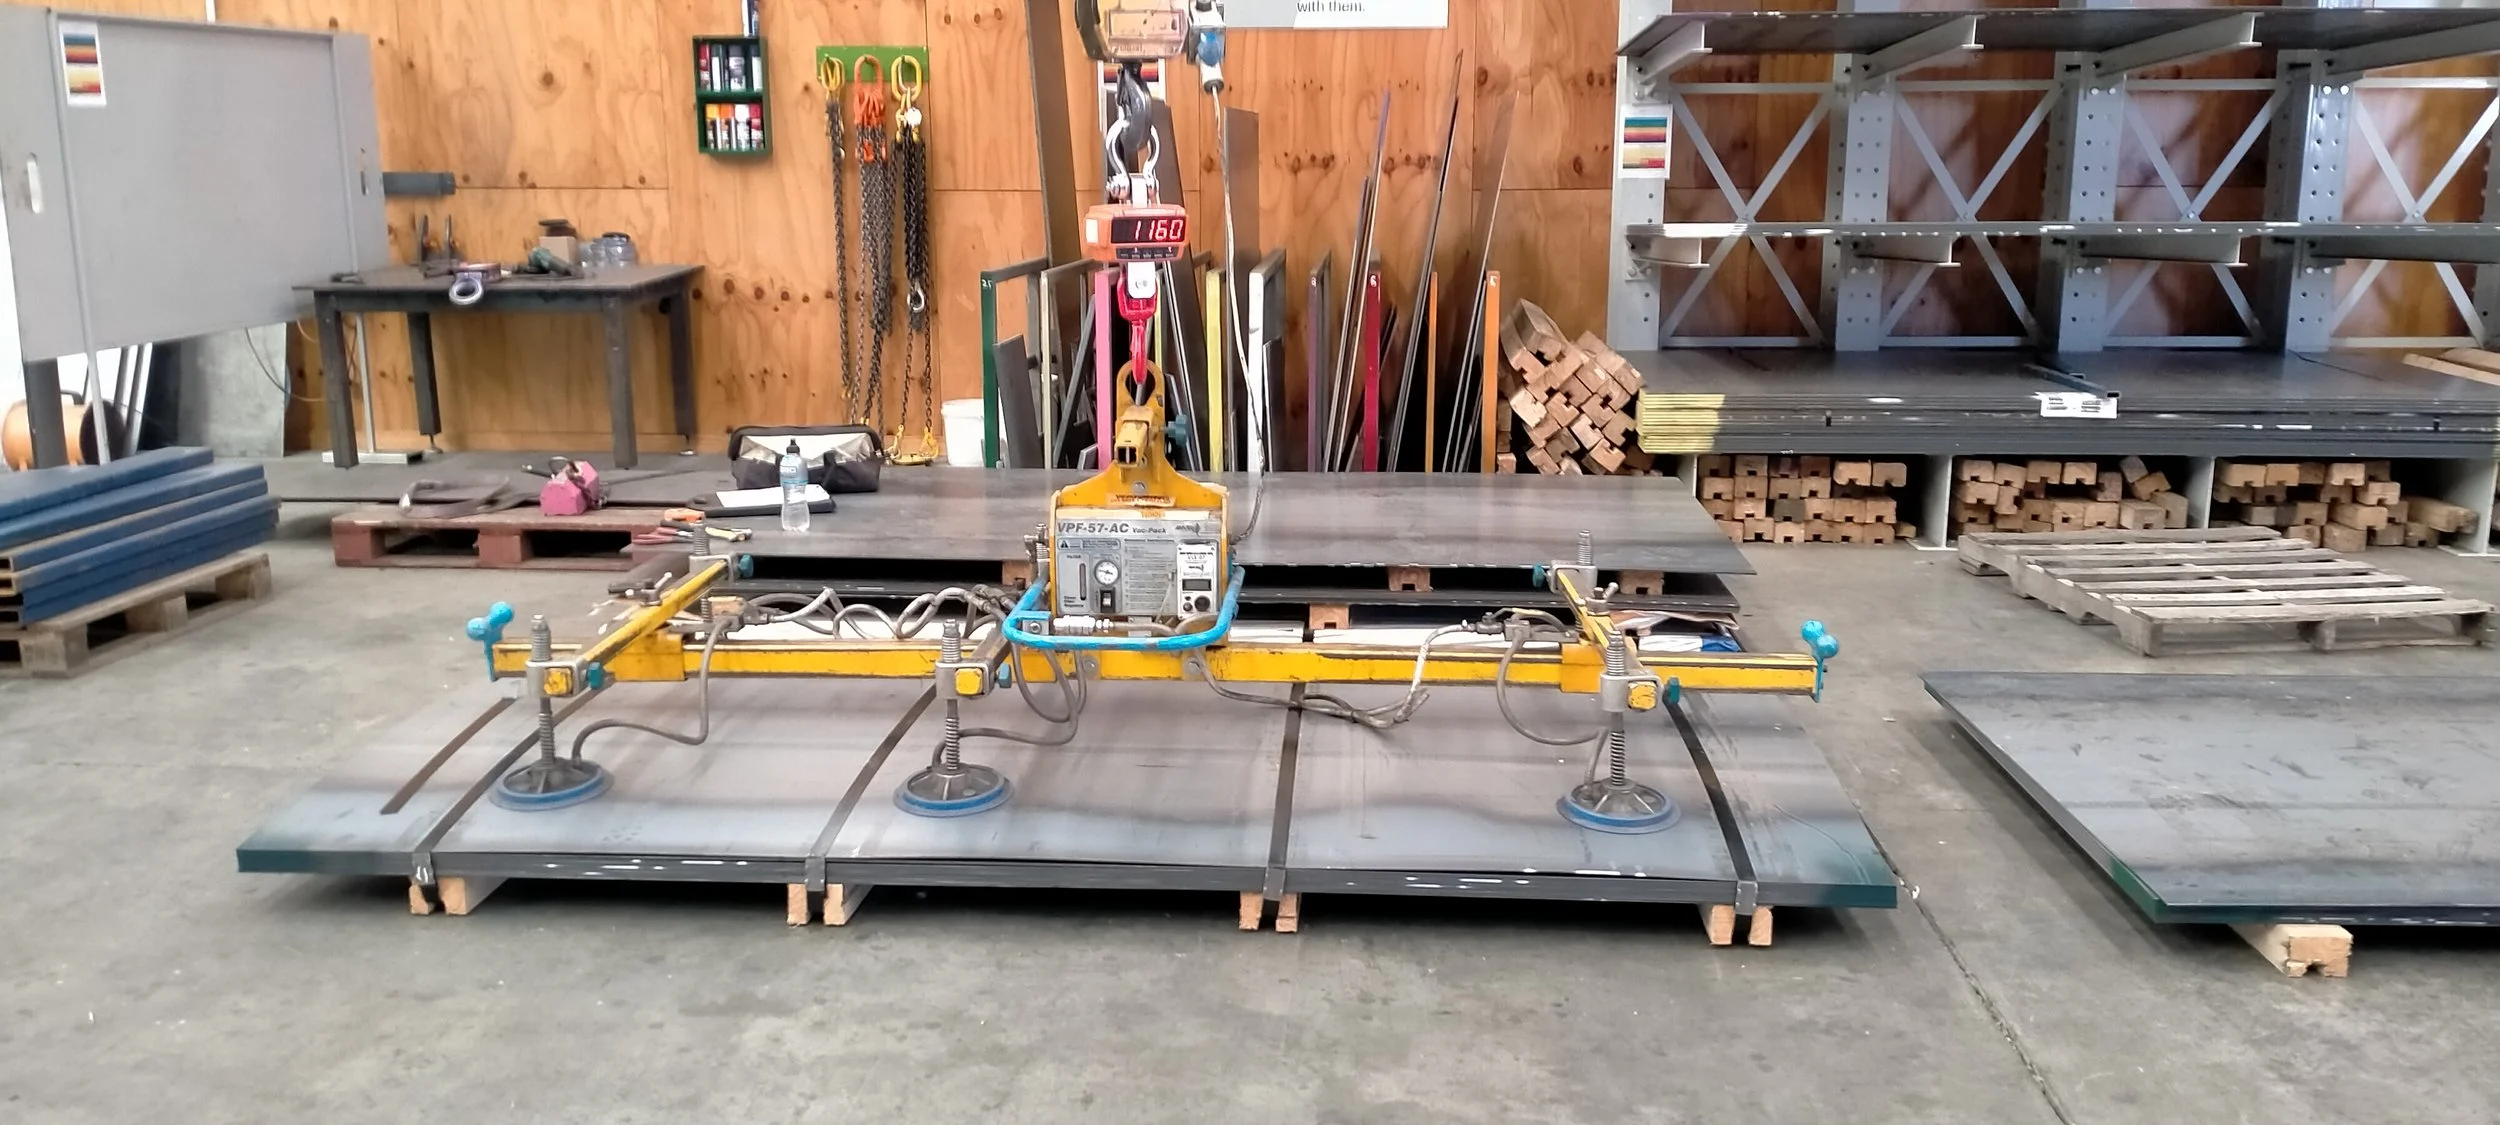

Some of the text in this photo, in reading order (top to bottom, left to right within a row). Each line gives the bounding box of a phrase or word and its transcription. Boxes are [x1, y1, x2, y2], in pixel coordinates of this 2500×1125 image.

[1297, 0, 1365, 12] with them.
[1135, 219, 1183, 240] 1160
[1057, 522, 1129, 533] VPF-57-AC
